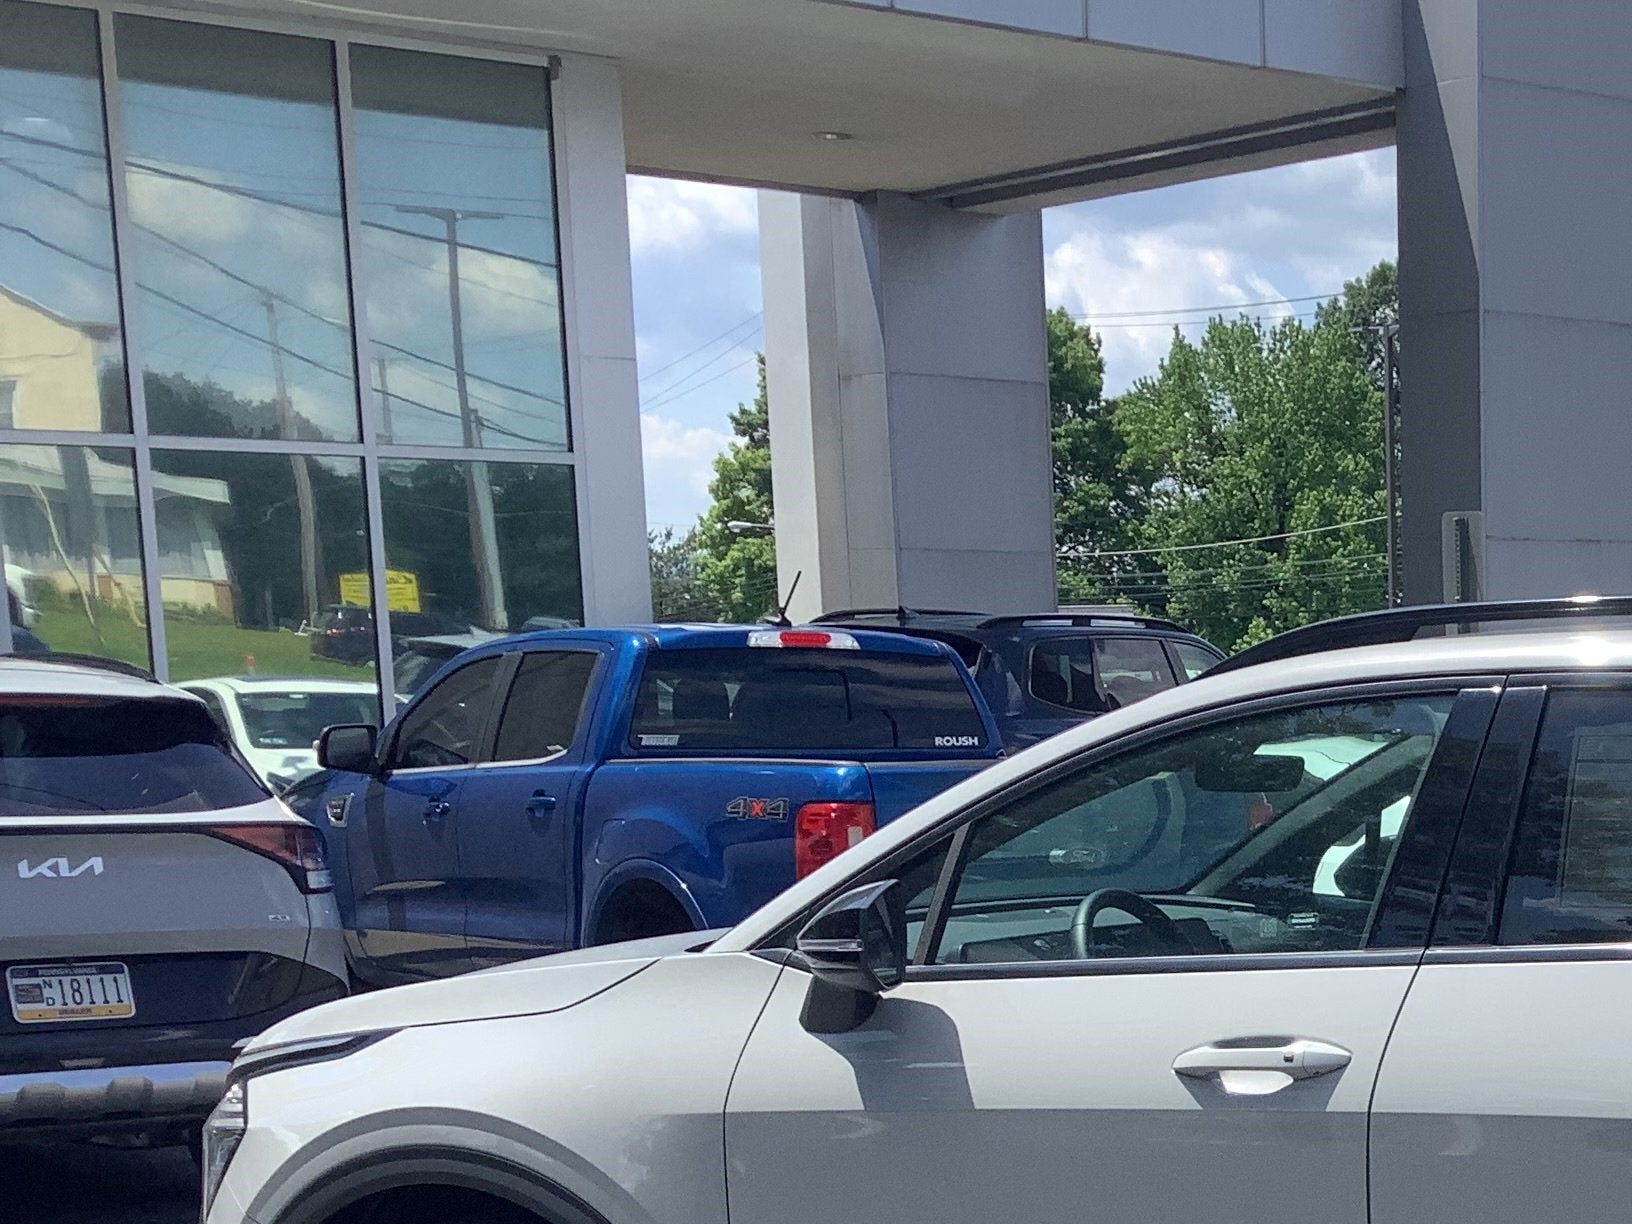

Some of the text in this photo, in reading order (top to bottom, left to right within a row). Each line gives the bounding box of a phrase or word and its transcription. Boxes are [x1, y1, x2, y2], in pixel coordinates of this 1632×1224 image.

[934, 736, 979, 747] ROUSH
[17, 856, 104, 879] KIA
[58, 976, 124, 1006] 18111
